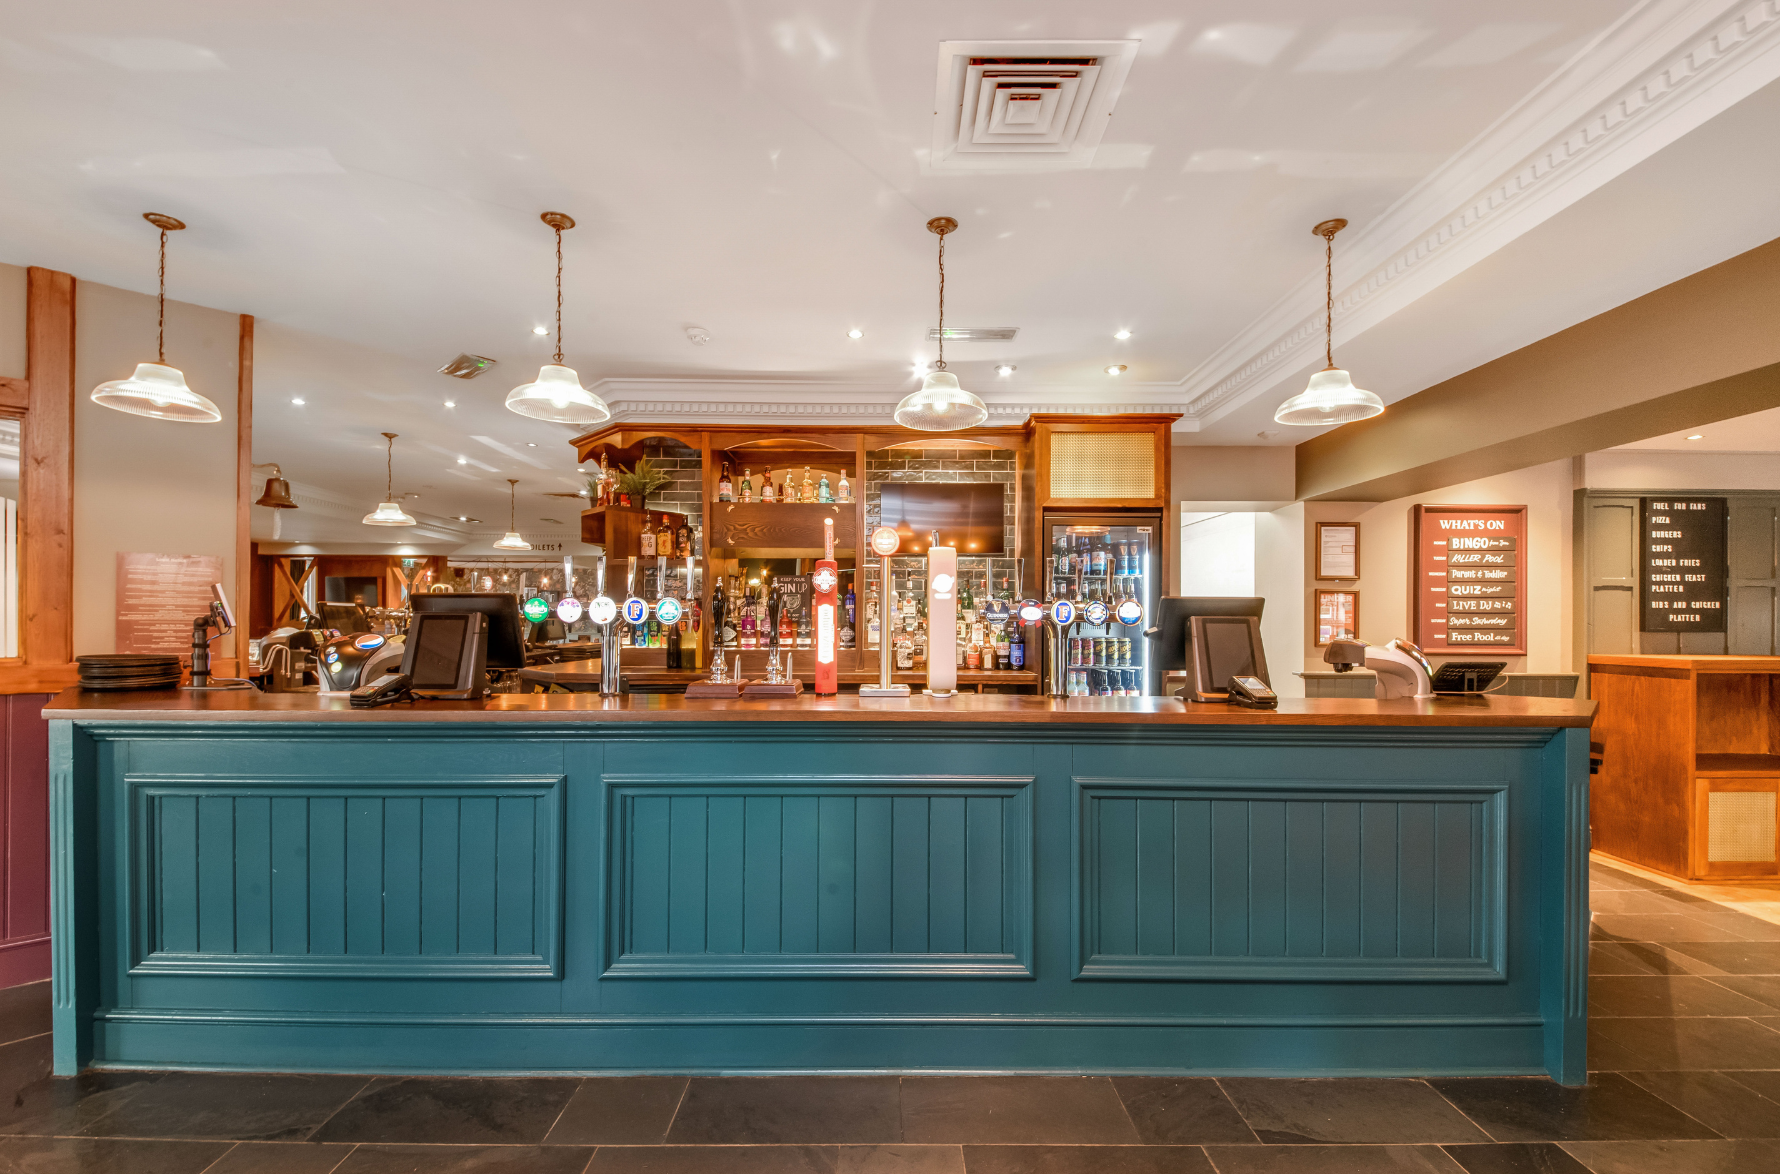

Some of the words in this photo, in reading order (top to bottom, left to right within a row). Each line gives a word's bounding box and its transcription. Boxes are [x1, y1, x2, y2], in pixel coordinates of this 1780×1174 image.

[1440, 520, 1484, 530] WHAT'S
[1486, 520, 1504, 530] ON
[1452, 538, 1488, 549] BINGO
[1452, 554, 1481, 562] KILLER
[1483, 554, 1504, 562] POOL
[1452, 570, 1476, 578] Parent
[1484, 570, 1508, 578] Toddler
[779, 583, 796, 593] GIN
[798, 583, 808, 593] UP
[1451, 586, 1482, 596] QUIZ
[1452, 601, 1476, 610] LIVE
[1480, 601, 1492, 610] DJ
[630, 604, 642, 618] F
[1058, 606, 1068, 620] F
[1450, 617, 1470, 626] Super
[1471, 617, 1507, 626] Saturday
[1452, 632, 1472, 640] Free
[1474, 632, 1494, 640] Pool
